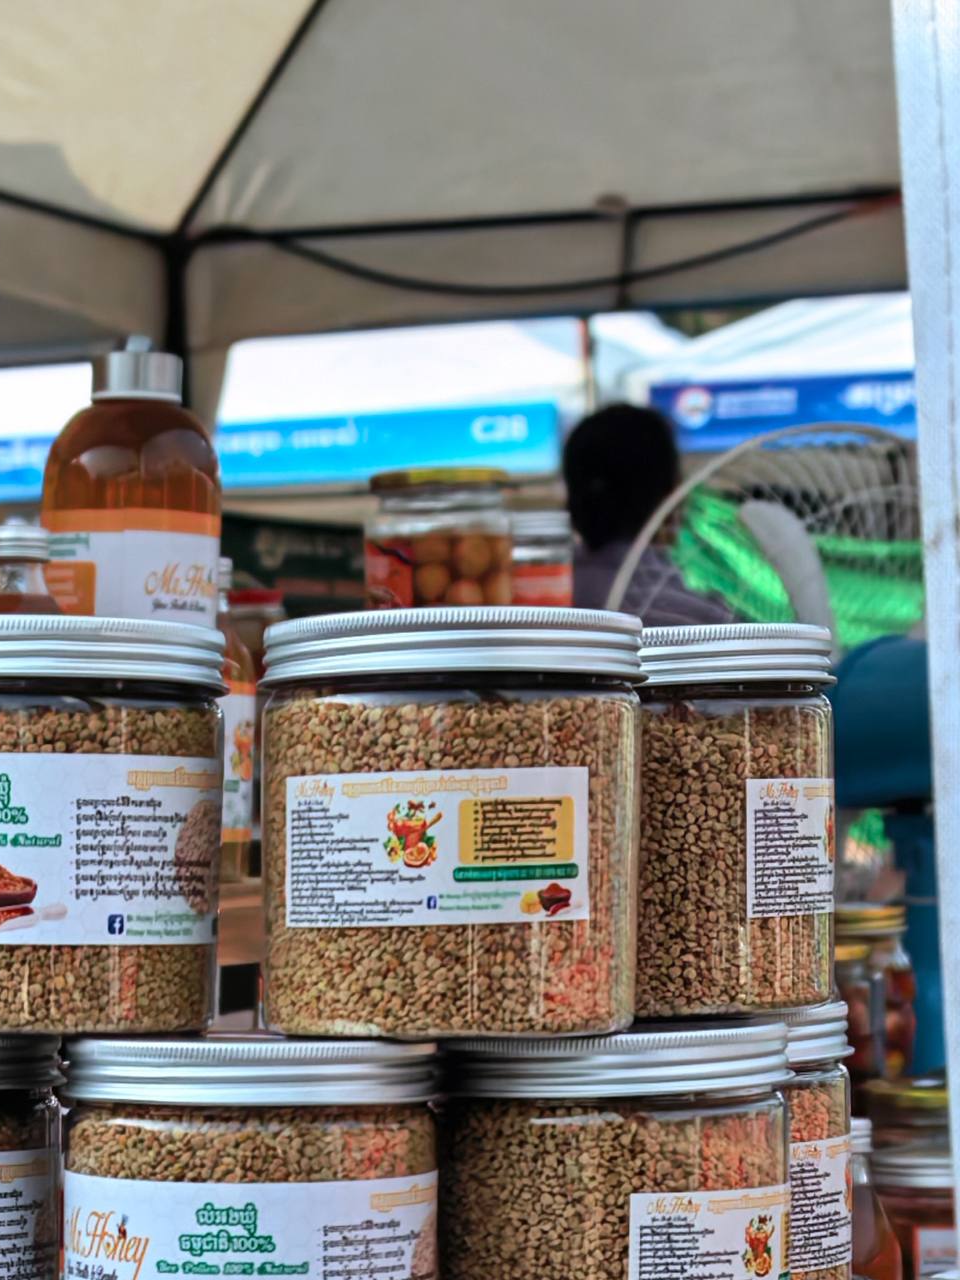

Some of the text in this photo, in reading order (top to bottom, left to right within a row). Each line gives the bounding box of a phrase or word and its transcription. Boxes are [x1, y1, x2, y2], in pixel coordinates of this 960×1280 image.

[10, 834, 61, 847] Natural
[232, 1235, 275, 1252] 100%
[156, 1260, 179, 1274] Bee
[182, 1261, 220, 1275] Pollen
[256, 1260, 309, 1275] Natural
